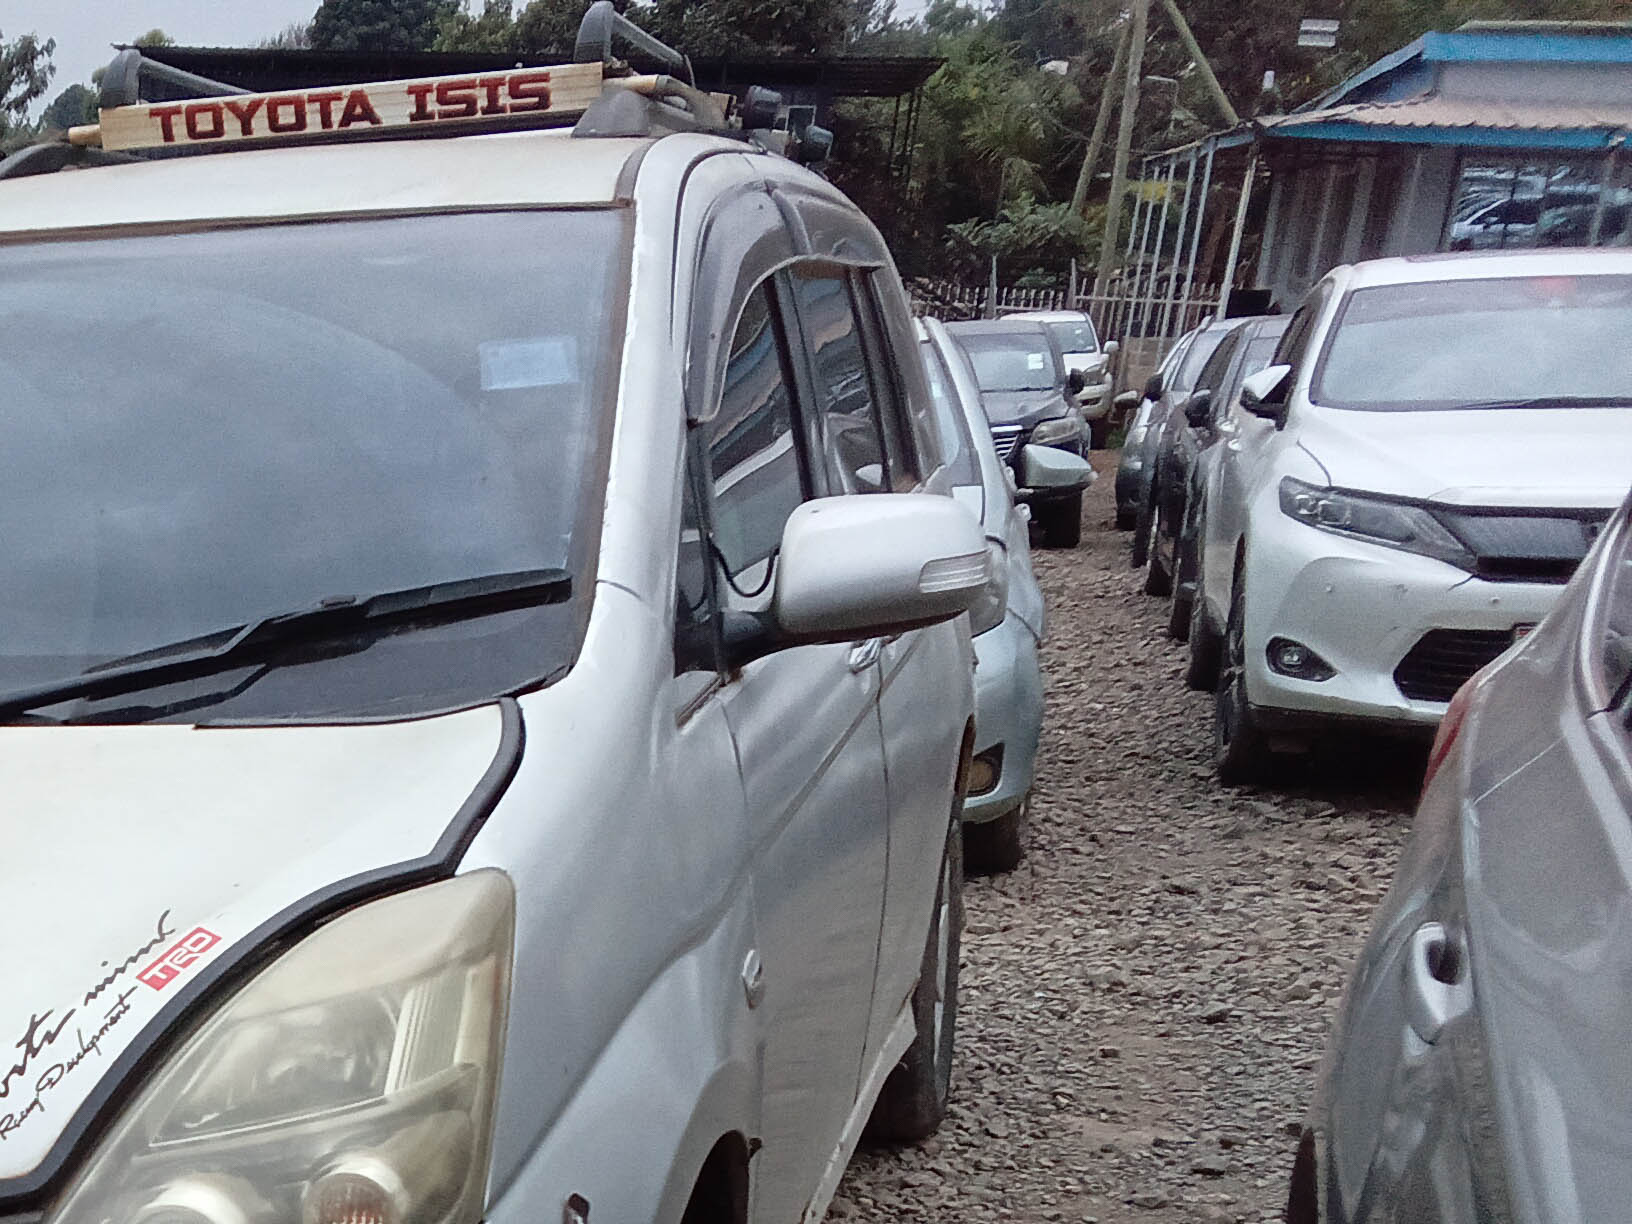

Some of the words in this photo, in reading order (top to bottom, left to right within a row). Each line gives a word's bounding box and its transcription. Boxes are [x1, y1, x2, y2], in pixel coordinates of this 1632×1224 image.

[148, 89, 383, 143] TOYOTA
[406, 72, 552, 123] ISIS
[140, 930, 216, 984] TRD
